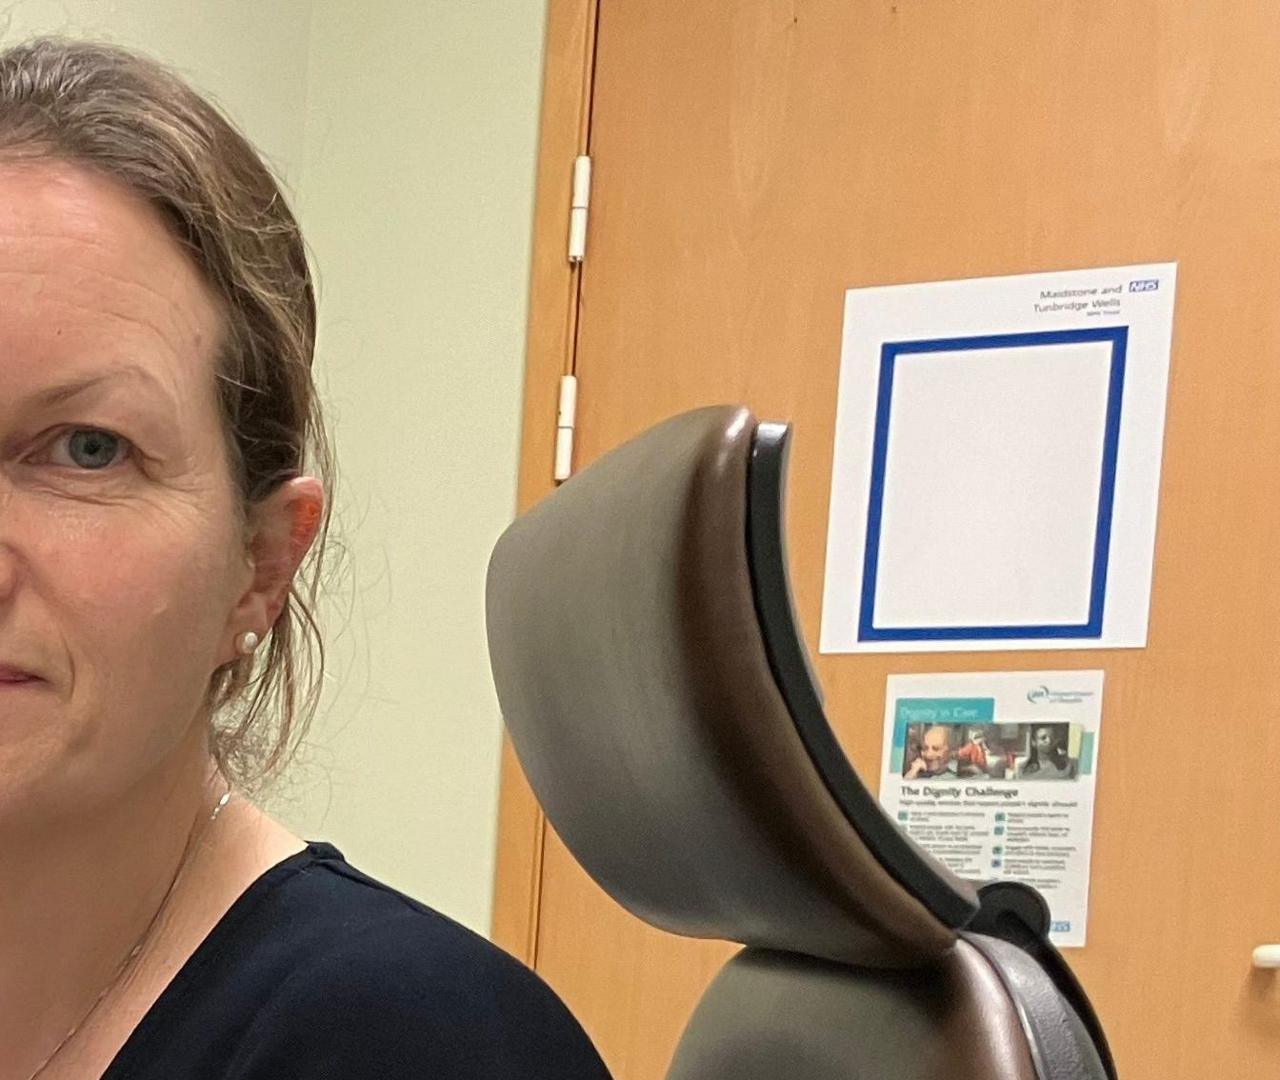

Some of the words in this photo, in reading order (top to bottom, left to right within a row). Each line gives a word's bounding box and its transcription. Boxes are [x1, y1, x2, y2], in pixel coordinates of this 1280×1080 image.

[1040, 288, 1098, 299] Maidstone
[1101, 285, 1122, 295] and
[1129, 280, 1160, 292] NHS
[1034, 302, 1089, 313] Tunbridge
[1092, 299, 1121, 308] Wells
[901, 786, 920, 797] The
[922, 786, 961, 799] Dignity
[965, 786, 1019, 799] Challenge
